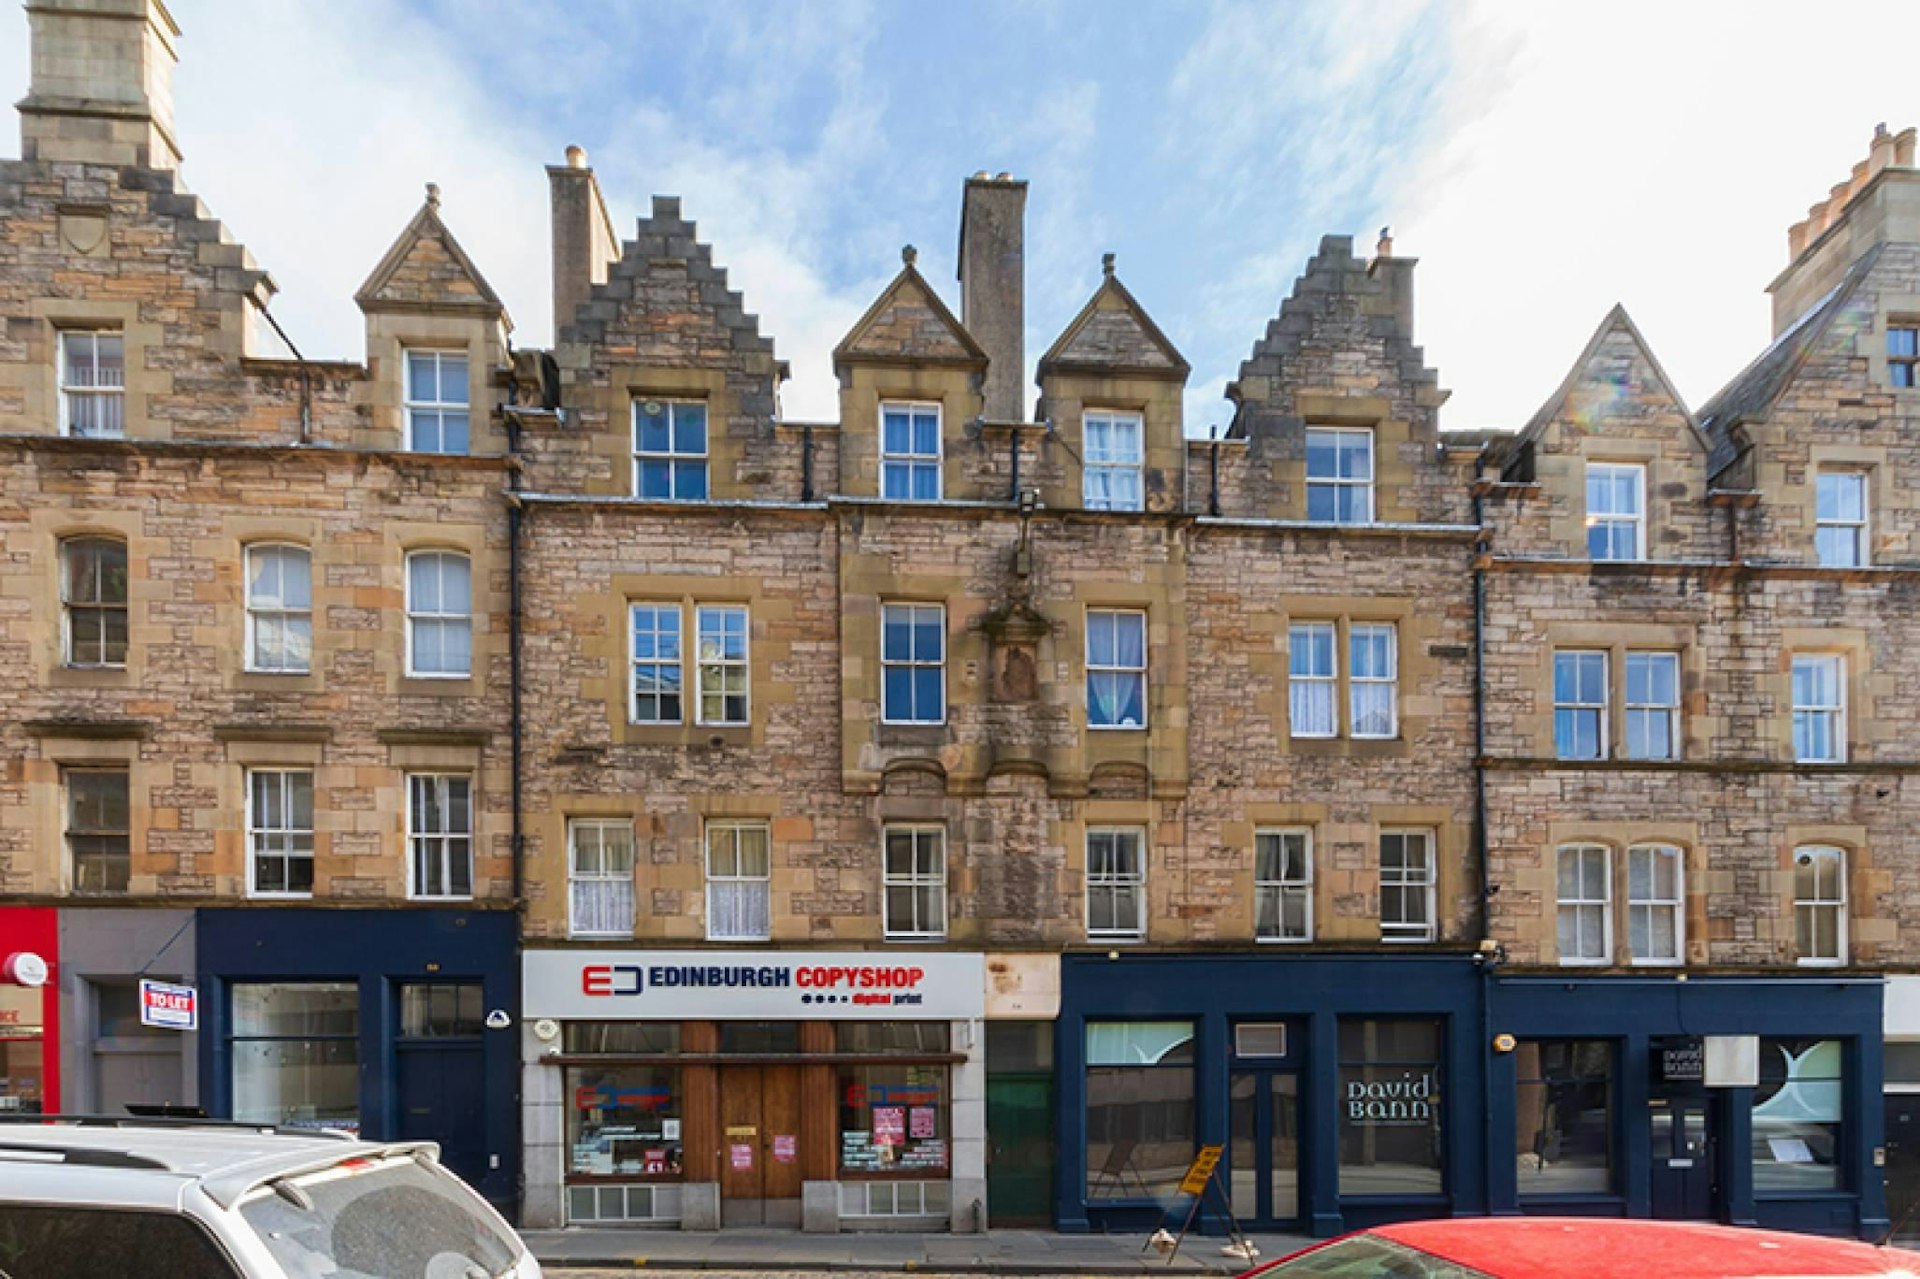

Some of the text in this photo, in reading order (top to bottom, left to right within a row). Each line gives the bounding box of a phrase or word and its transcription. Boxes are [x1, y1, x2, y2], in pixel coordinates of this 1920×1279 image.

[649, 966, 790, 987] EDINBURGH
[796, 966, 924, 987] COPYSHOP
[150, 992, 189, 1010] TO LET
[851, 992, 923, 1005] digital print
